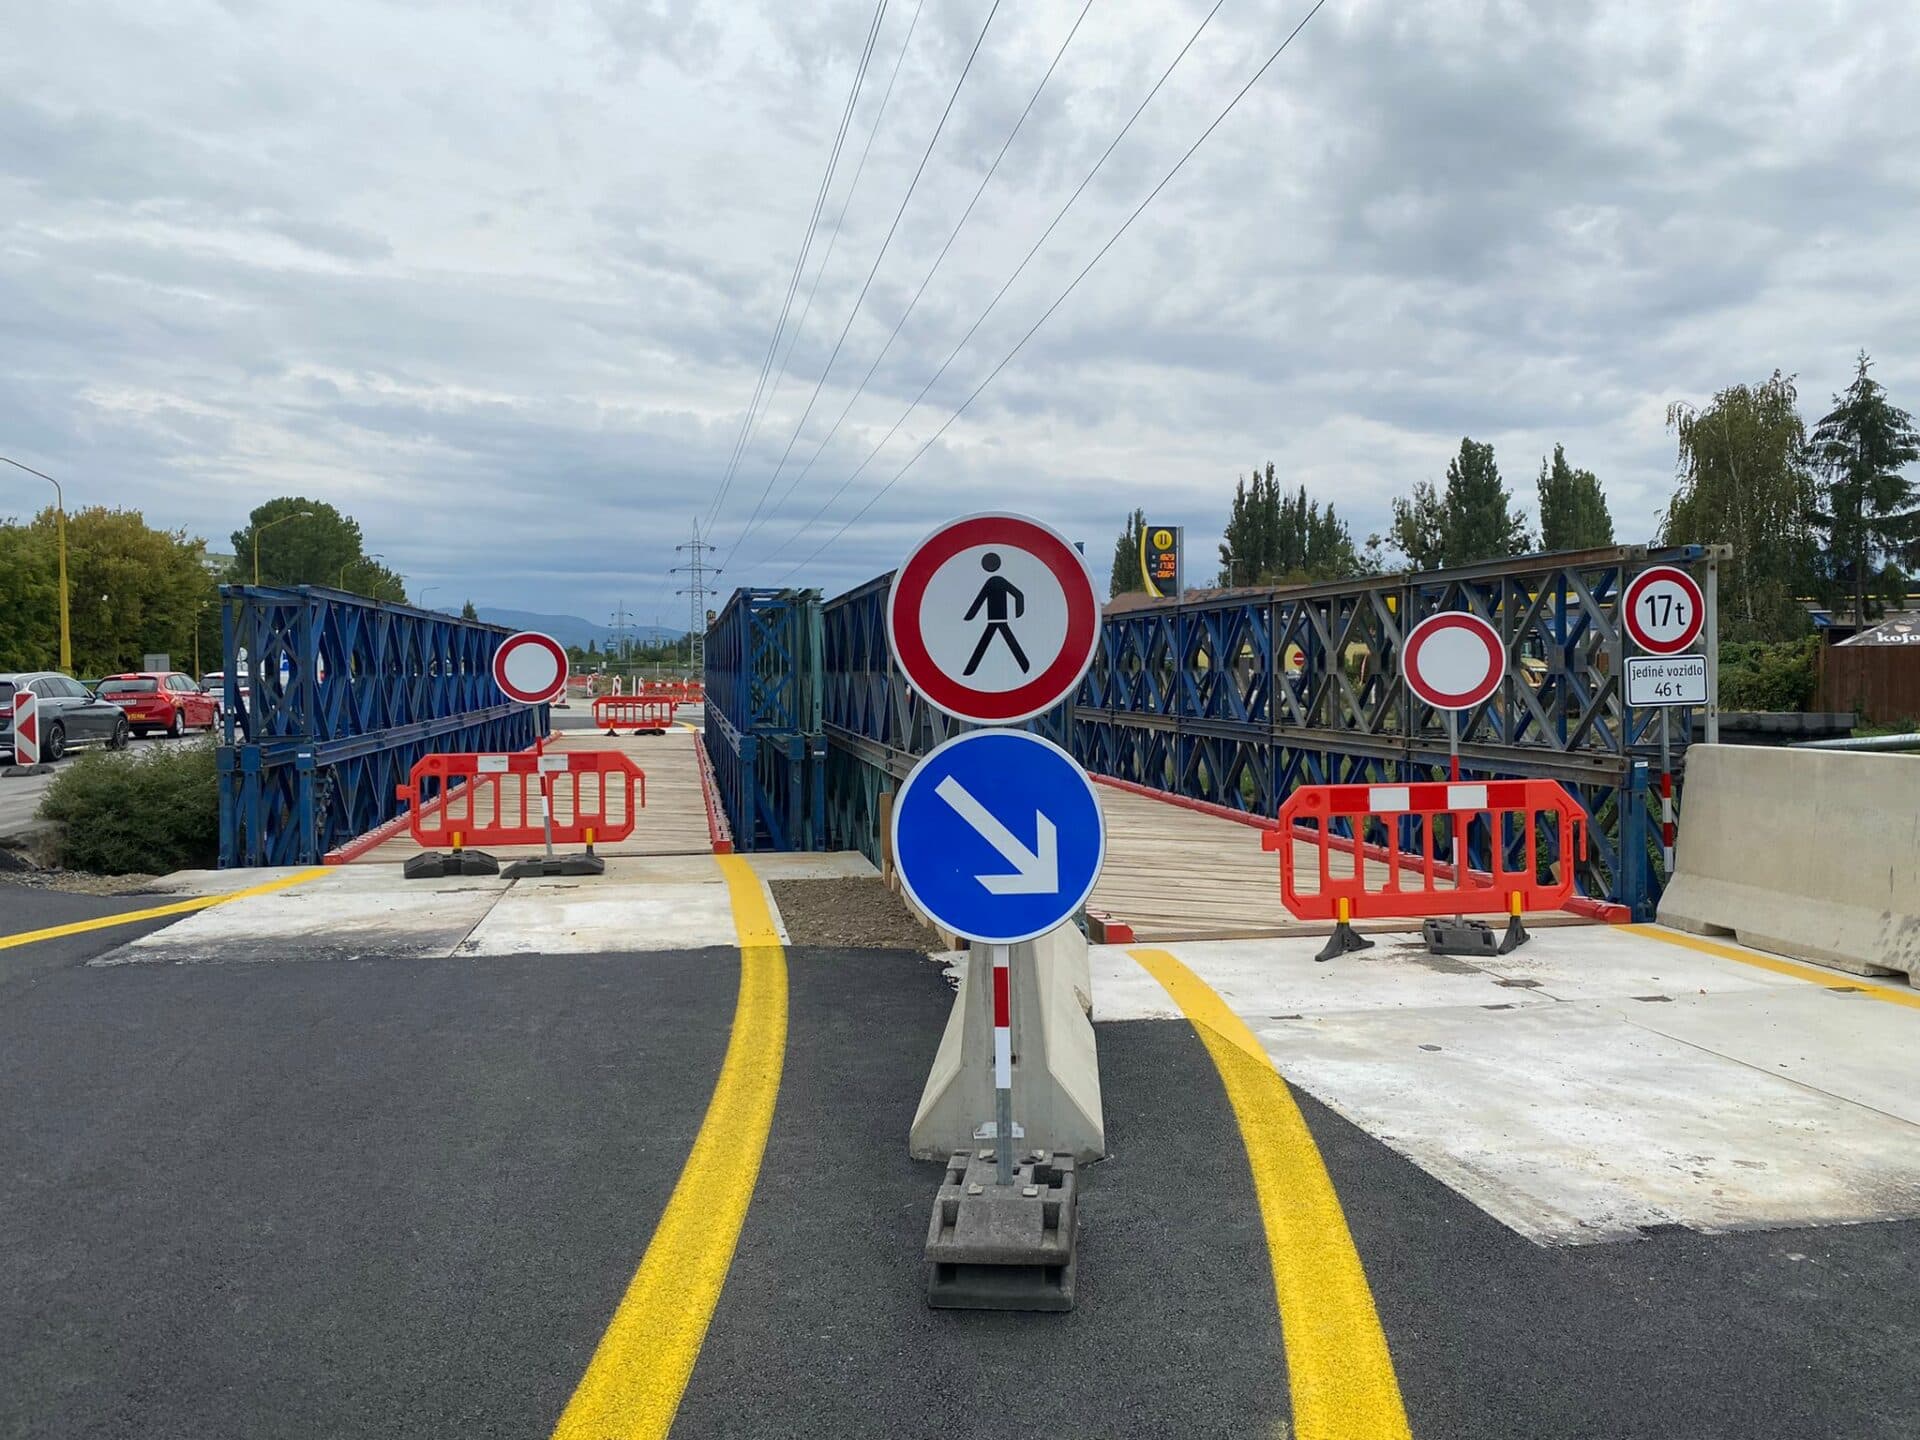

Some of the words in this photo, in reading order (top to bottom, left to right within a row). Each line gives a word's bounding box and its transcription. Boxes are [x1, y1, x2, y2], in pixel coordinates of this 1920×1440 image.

[1632, 665, 1664, 681] jediné
[1667, 664, 1703, 677] vozidlo
[1655, 682, 1672, 697] 46
[1675, 683, 1682, 697] t
